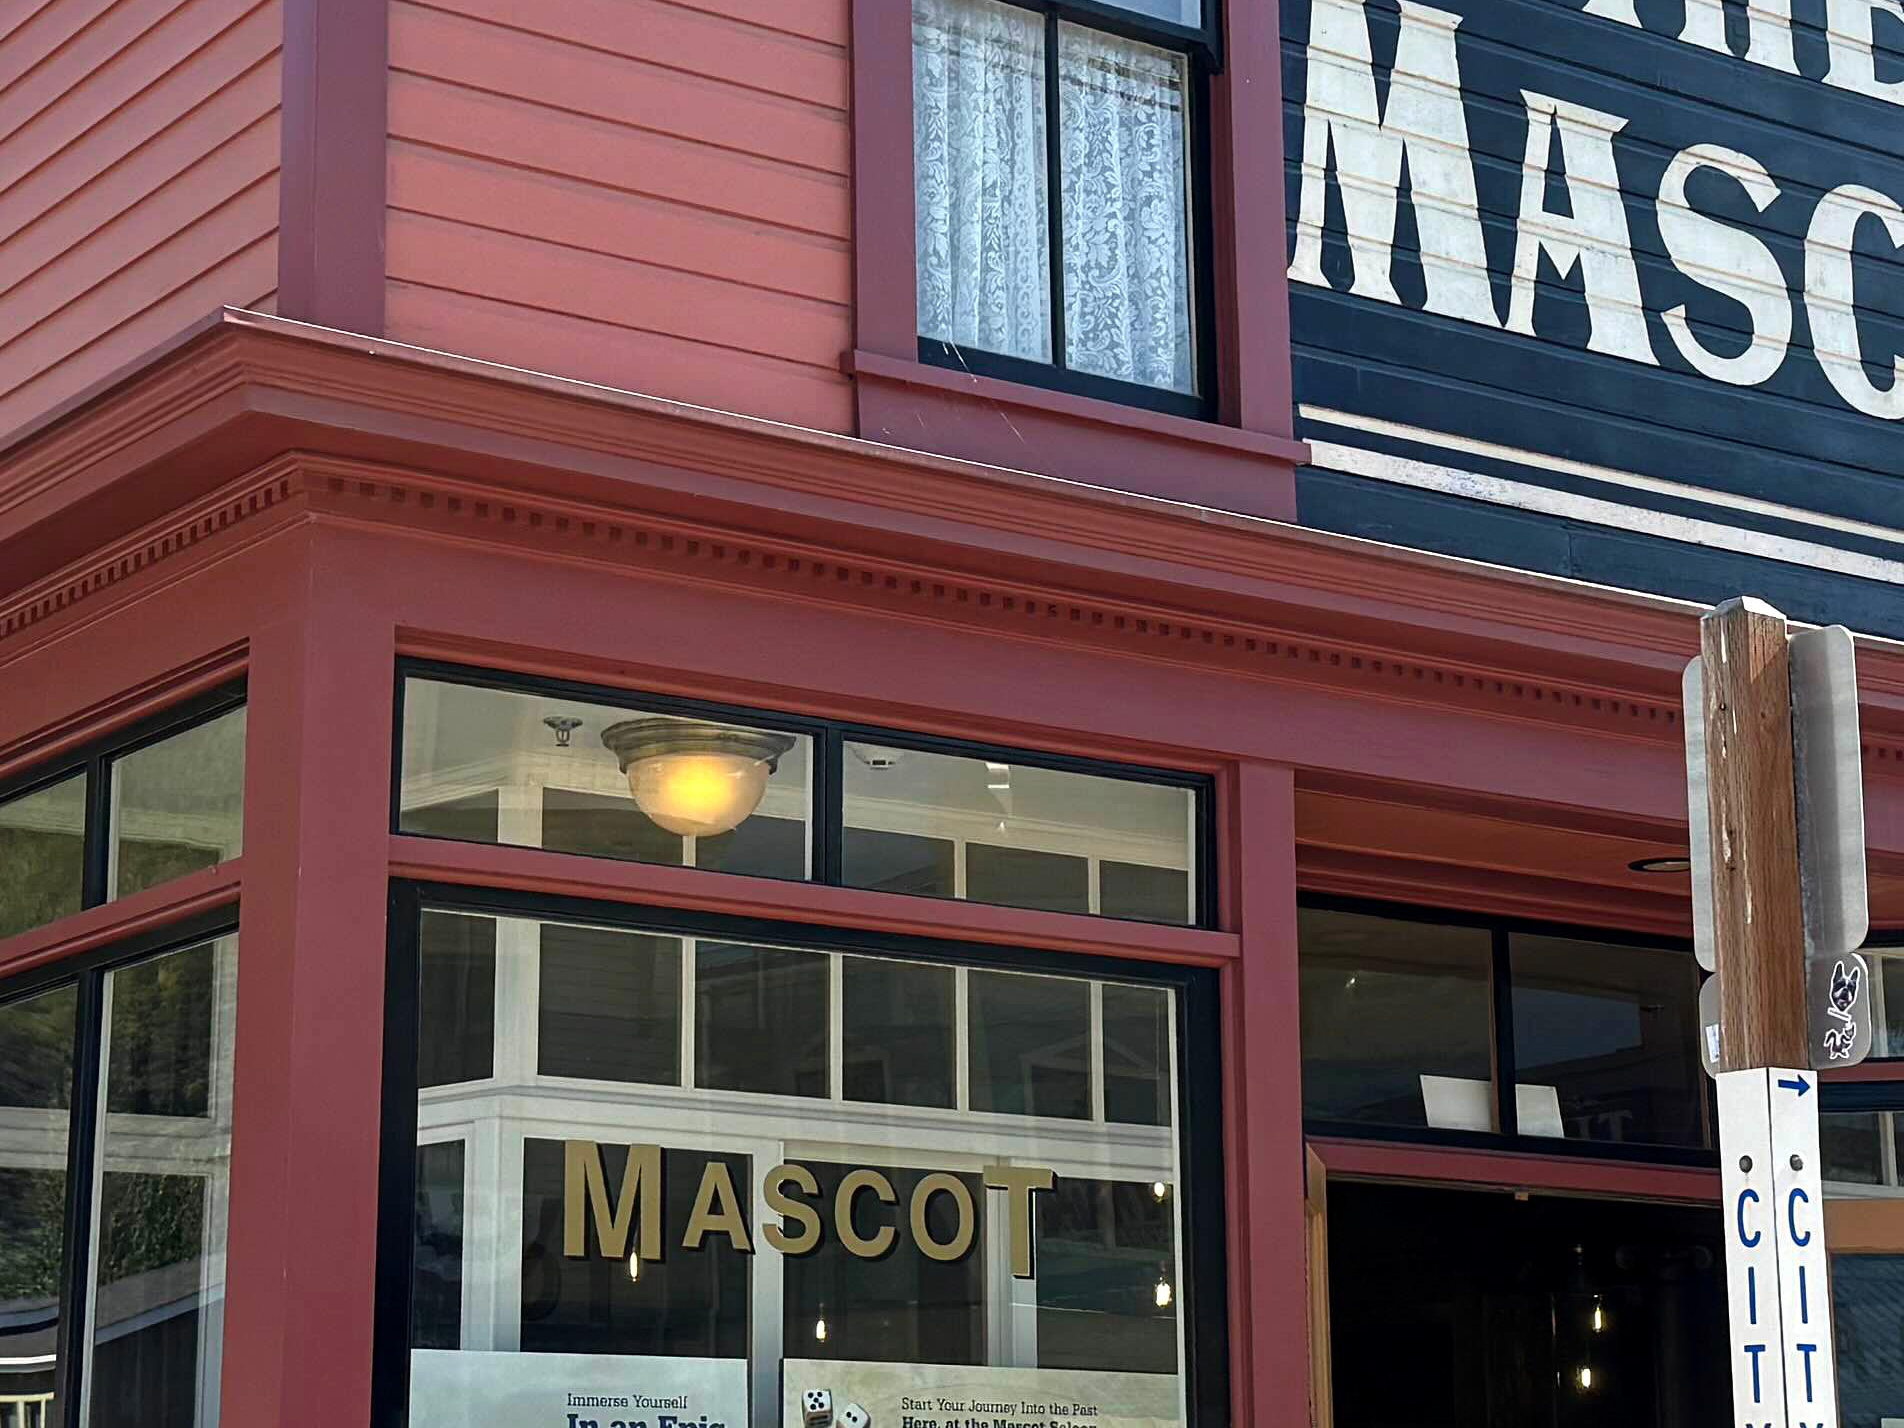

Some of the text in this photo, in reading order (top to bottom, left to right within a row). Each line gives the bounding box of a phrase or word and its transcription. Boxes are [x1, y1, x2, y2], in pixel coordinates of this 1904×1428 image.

[563, 1140, 1056, 1278] MASCOT
[568, 1394, 687, 1409] Immerse Yourself
[902, 1397, 1098, 1416] Start Your Journey Into the Past
